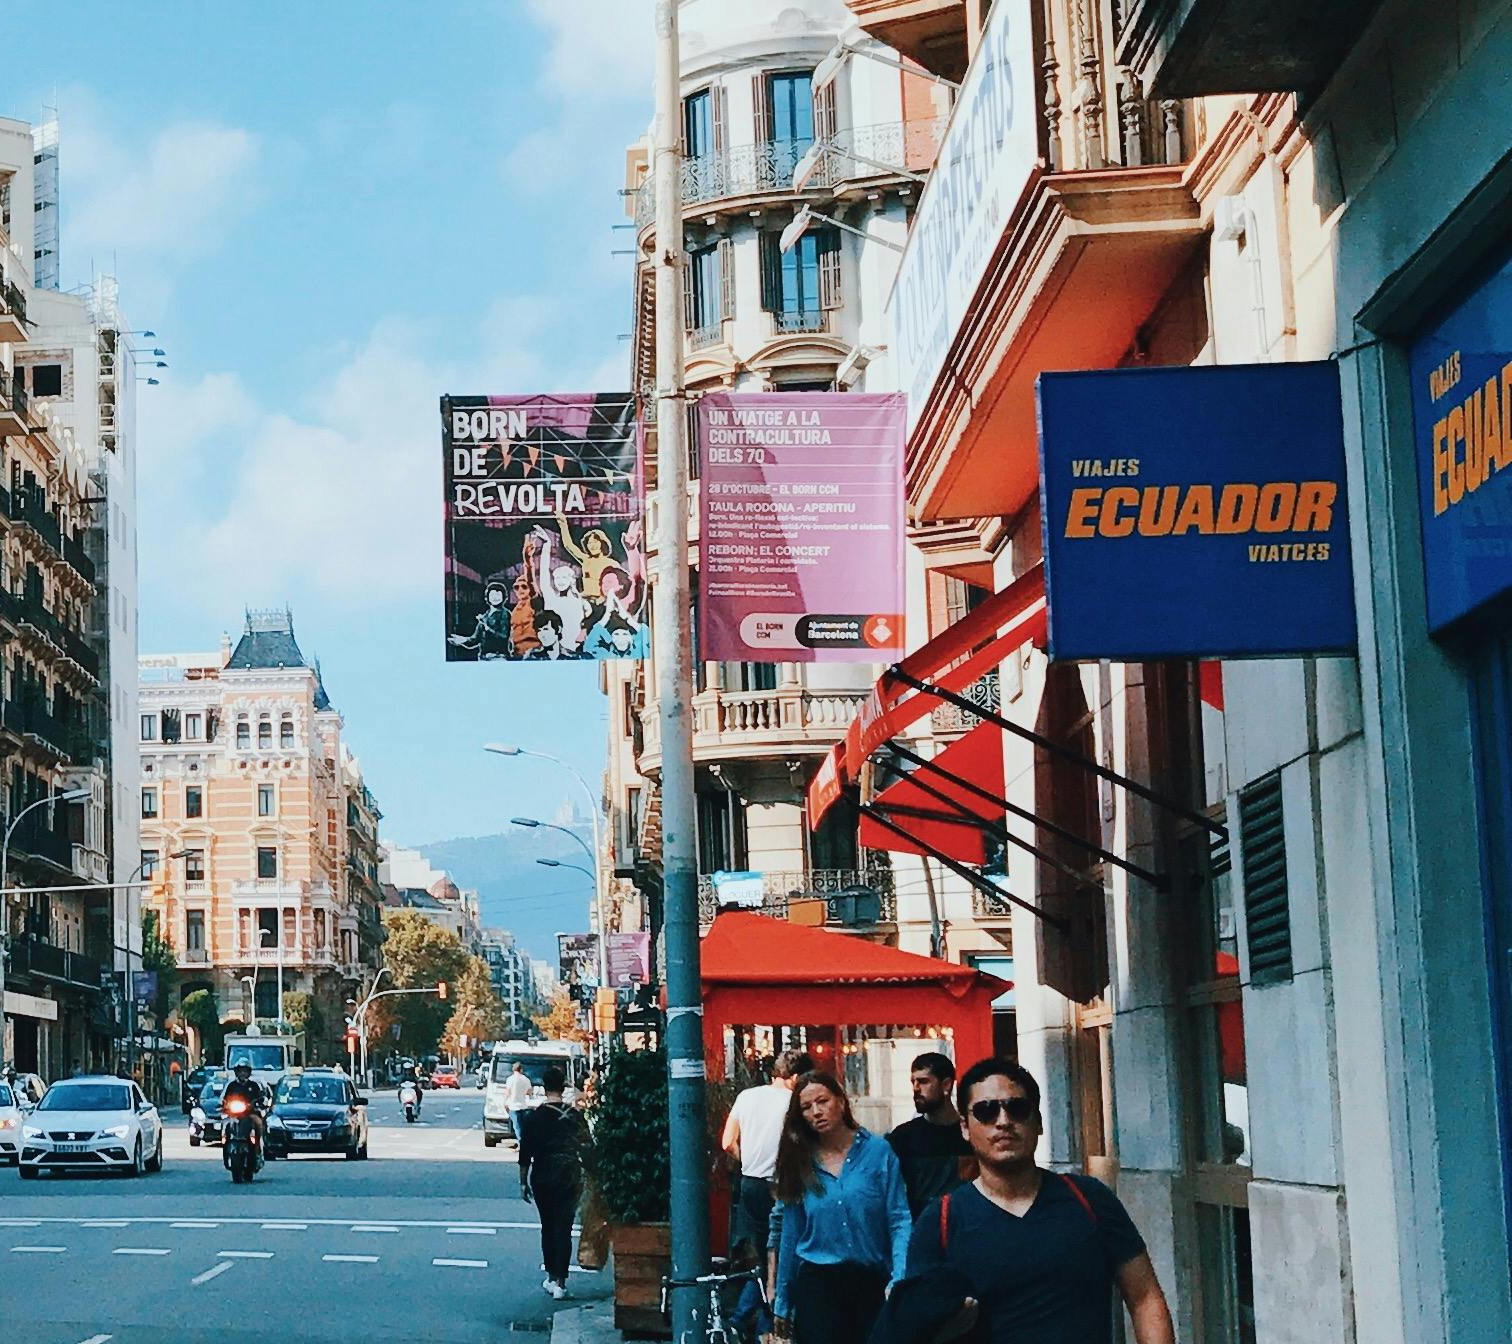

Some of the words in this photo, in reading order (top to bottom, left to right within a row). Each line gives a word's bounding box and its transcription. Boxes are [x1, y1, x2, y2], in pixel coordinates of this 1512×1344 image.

[452, 410, 527, 439] BORN
[709, 410, 728, 425] UN
[732, 410, 783, 426] VIATGE
[787, 410, 798, 425] A
[802, 410, 821, 425] LA
[708, 429, 832, 445] CONTRACULTURA
[453, 448, 488, 476] DE
[709, 448, 744, 463] DELS
[746, 448, 765, 463] 70
[1071, 458, 1140, 478] VIAJES
[779, 484, 789, 494] EL
[792, 484, 817, 494] BORN
[454, 481, 586, 516] REVOLTA
[709, 501, 744, 512] TAULA
[746, 501, 794, 513] RODONA
[803, 502, 856, 513] APERITIU
[1063, 480, 1338, 539] ECUADOR
[708, 545, 758, 556] REBORN:
[760, 546, 773, 556] EL
[775, 546, 831, 557] CONCERT
[756, 622, 765, 631] EL
[766, 623, 784, 631] BORN
[808, 621, 847, 631] Ajuntament
[848, 622, 859, 630] de
[808, 630, 859, 640] Barcelona
